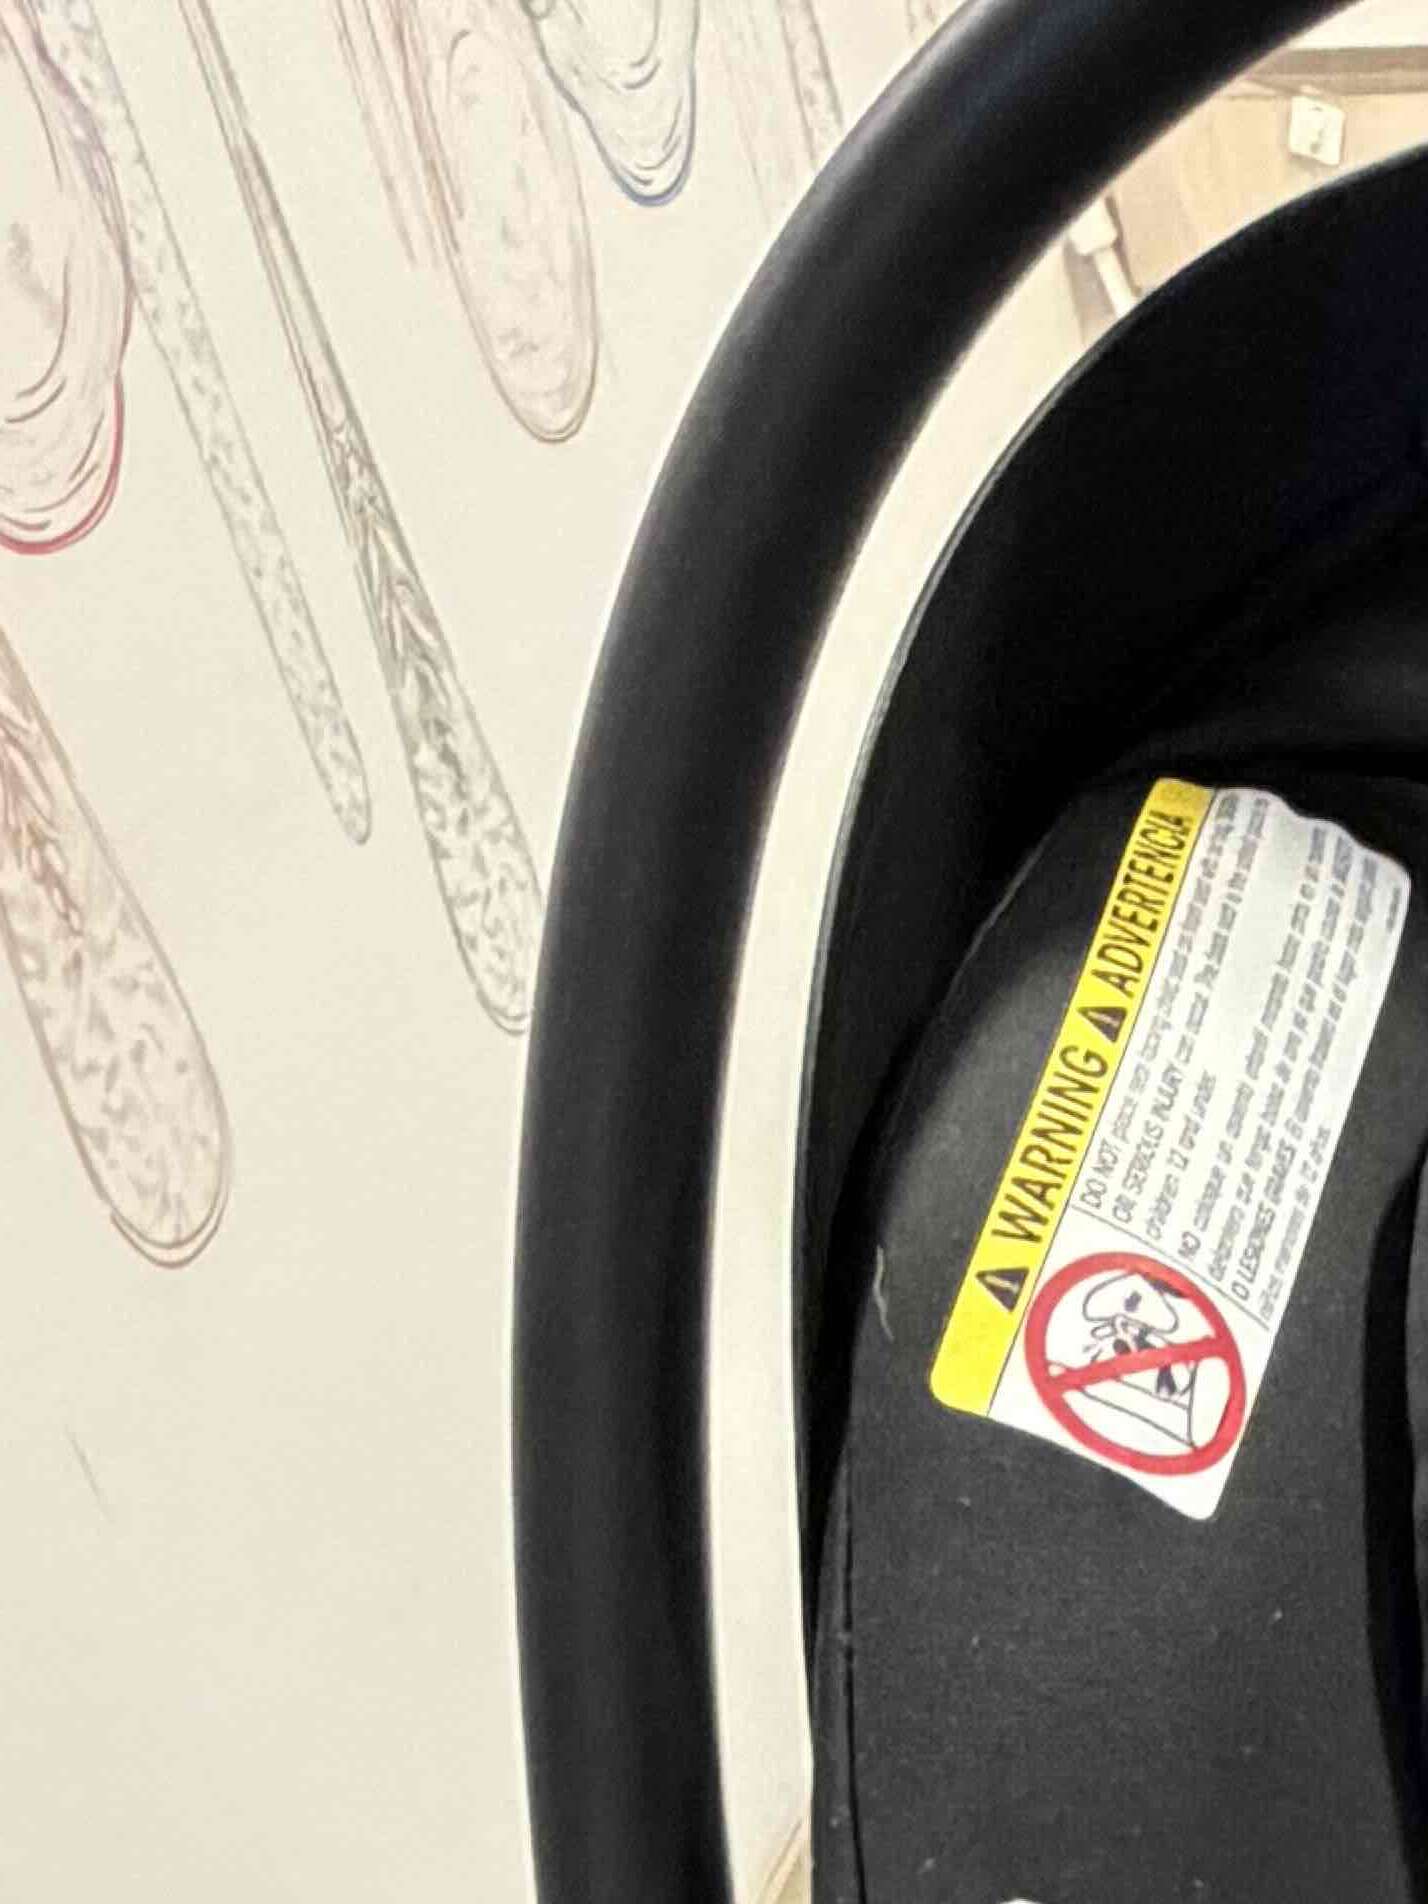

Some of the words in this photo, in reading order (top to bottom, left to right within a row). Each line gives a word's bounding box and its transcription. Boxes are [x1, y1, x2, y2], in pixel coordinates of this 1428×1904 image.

[1151, 1063, 1182, 1122] INJURY
[994, 1046, 1106, 1242] WARNING
[1178, 1114, 1201, 1150] and
[1092, 1138, 1119, 1178] NOT
[1122, 1120, 1164, 1195] SERIOUS
[1079, 1178, 1108, 1210] DO
[1112, 1194, 1137, 1224] OR
[1177, 1231, 1201, 1259] NO
[1238, 1202, 1275, 1284] LESIONES
